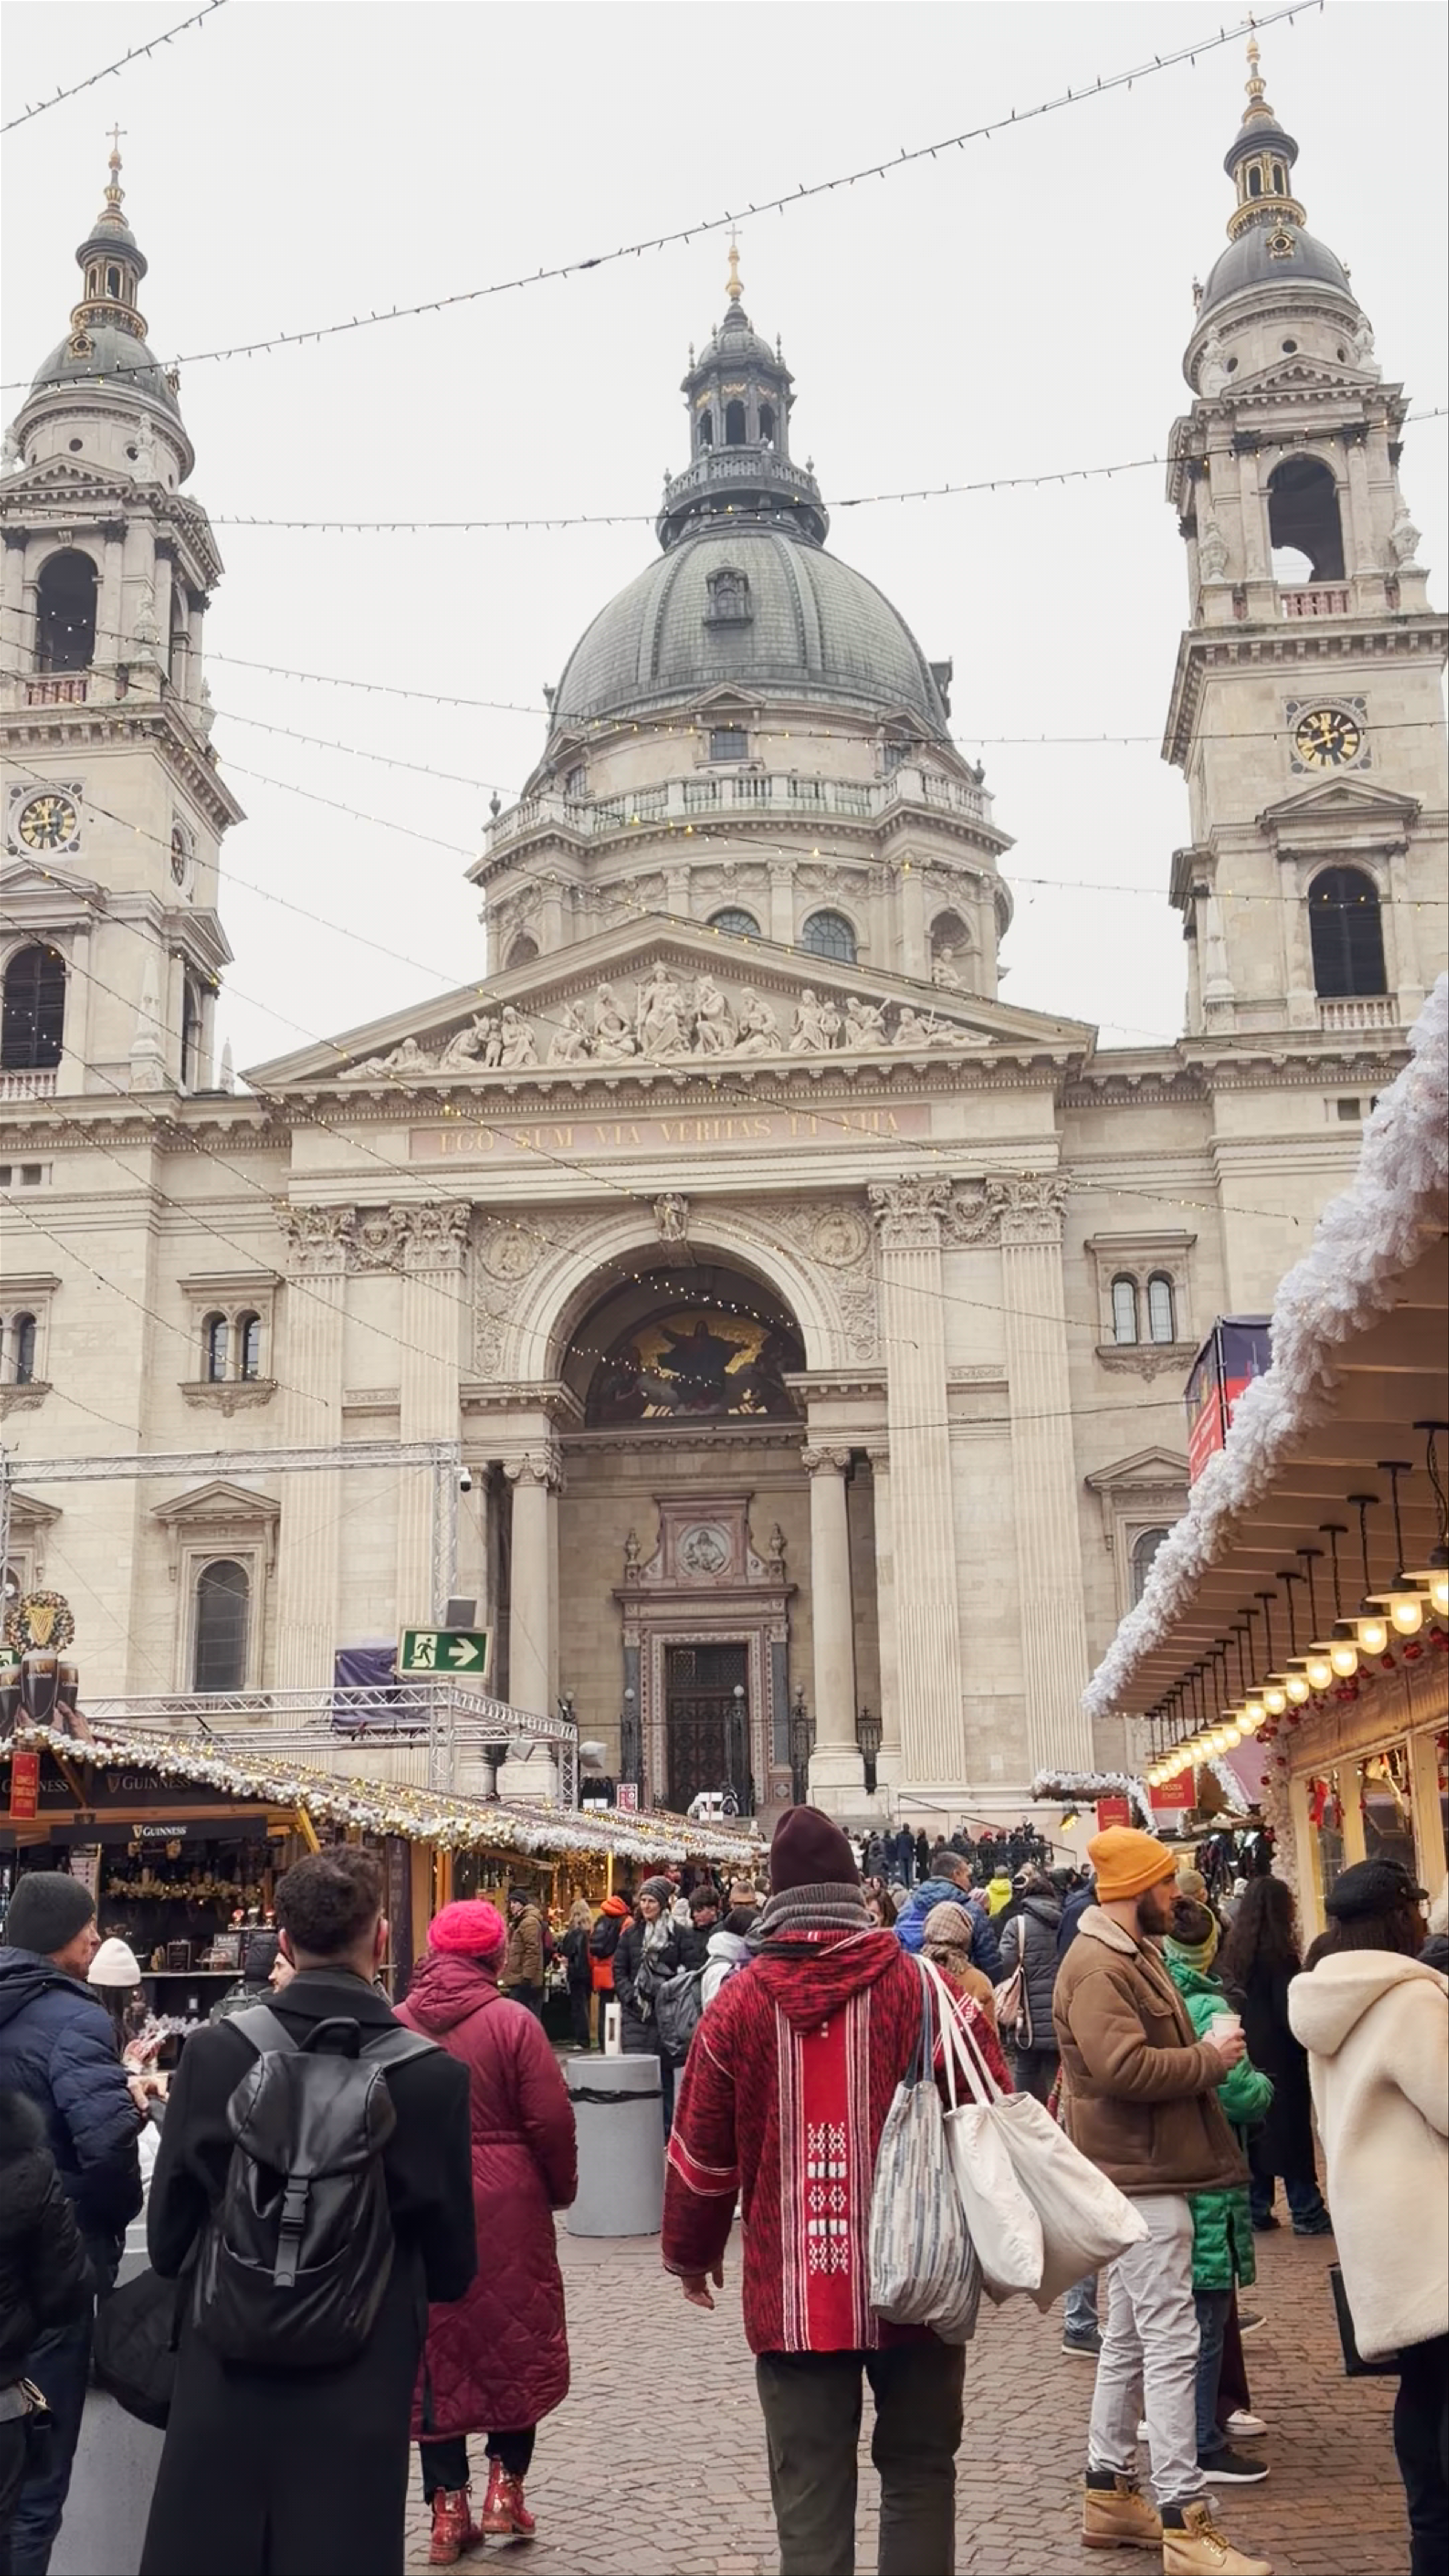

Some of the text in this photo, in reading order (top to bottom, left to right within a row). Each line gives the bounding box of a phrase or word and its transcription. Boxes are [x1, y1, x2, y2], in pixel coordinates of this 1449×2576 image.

[440, 1131, 494, 1155] EGO
[515, 1127, 574, 1150] SUM
[594, 1126, 641, 1145] VIA
[660, 1118, 772, 1142] VERITAS
[841, 1112, 900, 1134] VITA
[1, 1779, 69, 1793] GNESS
[122, 1775, 191, 1790] GUINNESS
[142, 1825, 188, 1837] GUINNESS
